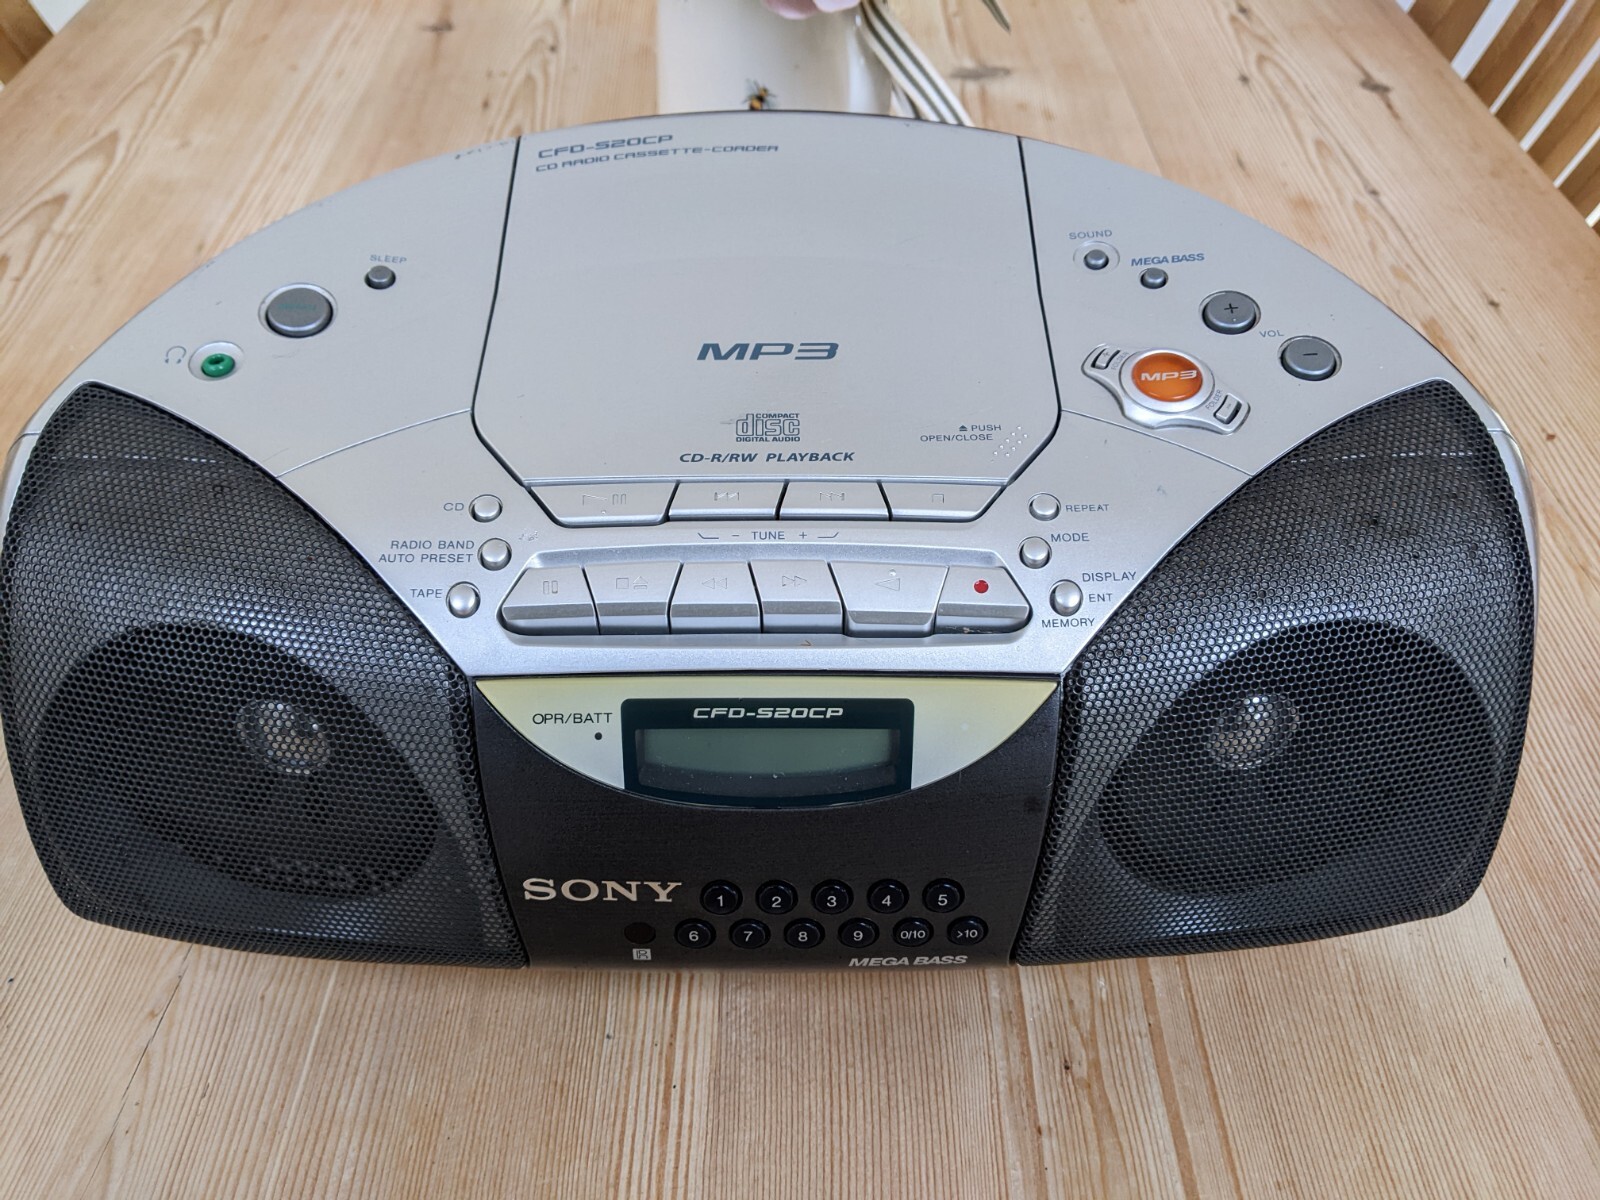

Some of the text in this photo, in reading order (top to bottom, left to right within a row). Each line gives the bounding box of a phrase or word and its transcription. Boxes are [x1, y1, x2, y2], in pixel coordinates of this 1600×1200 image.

[537, 134, 674, 159] CFD-S20CP
[535, 145, 780, 172] CD RADIO CASSETTE-CORDER
[1068, 229, 1113, 240] SOUND
[369, 254, 407, 264] SLEEP
[1131, 253, 1205, 266] MEGA BASS
[1259, 329, 1284, 338] VOL
[696, 342, 840, 361] MP3
[1140, 369, 1198, 382] MP3
[1204, 388, 1224, 411] FOLDER
[735, 412, 800, 437] disc
[970, 423, 1002, 432] PUSH
[919, 432, 994, 443] OPEN/CLOSE
[679, 451, 856, 464] CD-R/RW PLAYBACK
[443, 502, 465, 512] CD
[1065, 503, 1110, 513] REPEAT
[751, 531, 786, 541] TUNE
[1050, 532, 1090, 543] MODE
[390, 539, 475, 550] RADIO BAND
[379, 552, 474, 564] AUTO PRESET
[1081, 571, 1137, 583] DISPLAY
[410, 587, 443, 599] TAPE
[1088, 593, 1113, 603] ENT
[1041, 617, 1096, 628] MEMORY
[532, 712, 613, 725] OPR/BATT
[692, 707, 845, 719] CFD-S20CP
[522, 878, 682, 902] SONY
[716, 895, 725, 907] 1
[771, 896, 782, 908] 2
[826, 895, 837, 907] 3
[881, 895, 892, 907] 4
[937, 894, 949, 906] 5
[688, 930, 699, 942] 6
[743, 930, 754, 942] 7
[798, 930, 809, 942] 8
[852, 930, 864, 942] 9
[900, 929, 926, 940] 0/10
[848, 955, 968, 967] MEGA BASS
